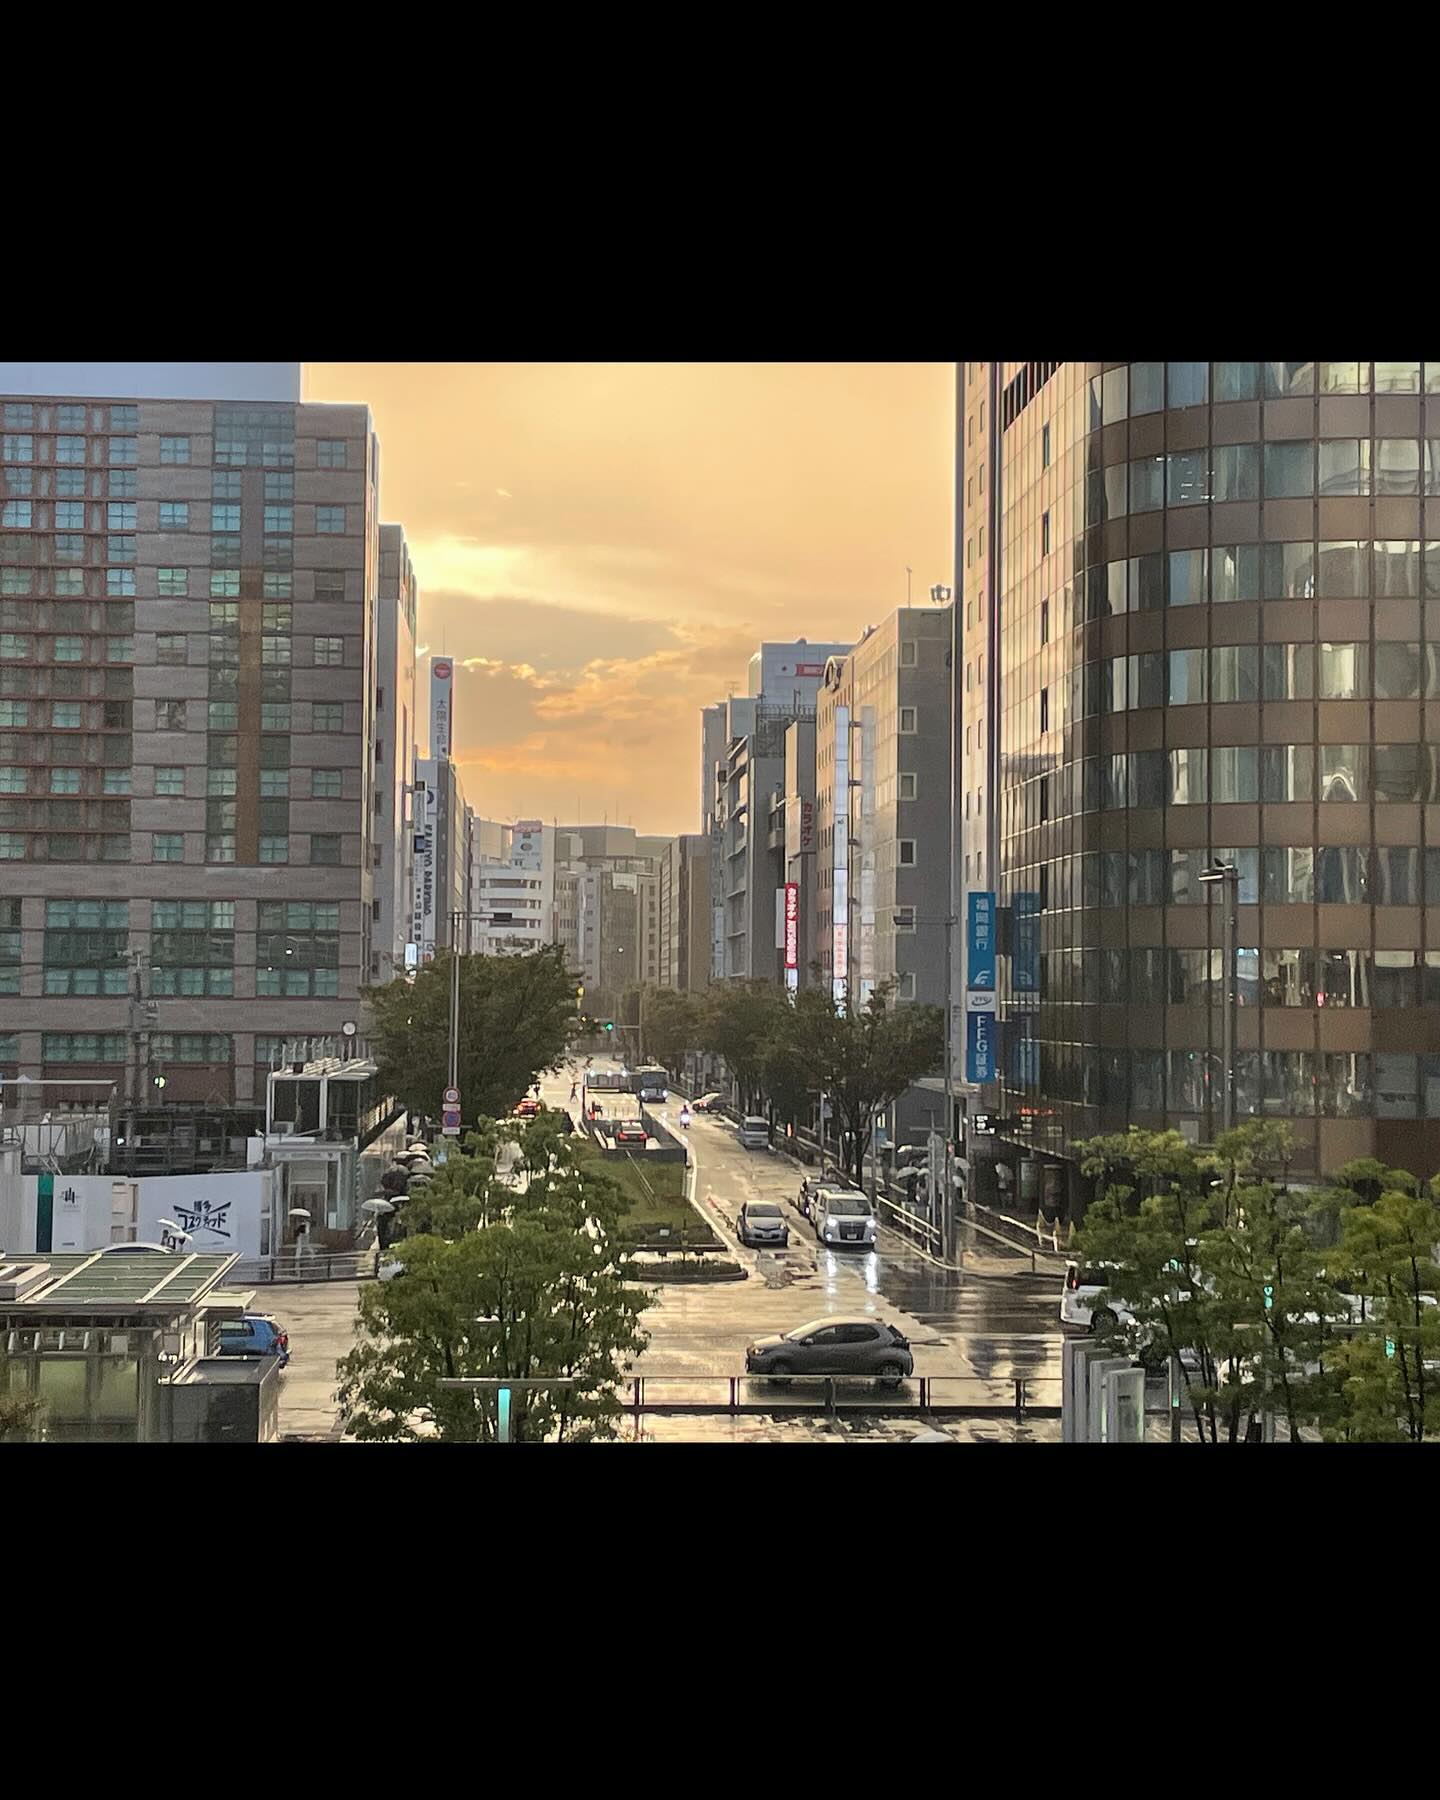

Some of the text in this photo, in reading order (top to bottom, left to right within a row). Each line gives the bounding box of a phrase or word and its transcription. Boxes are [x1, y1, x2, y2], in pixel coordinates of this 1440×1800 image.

[802, 801, 813, 847] カラオケ
[975, 897, 989, 951] 福岡銀行
[976, 1015, 988, 1079] FFG証券
